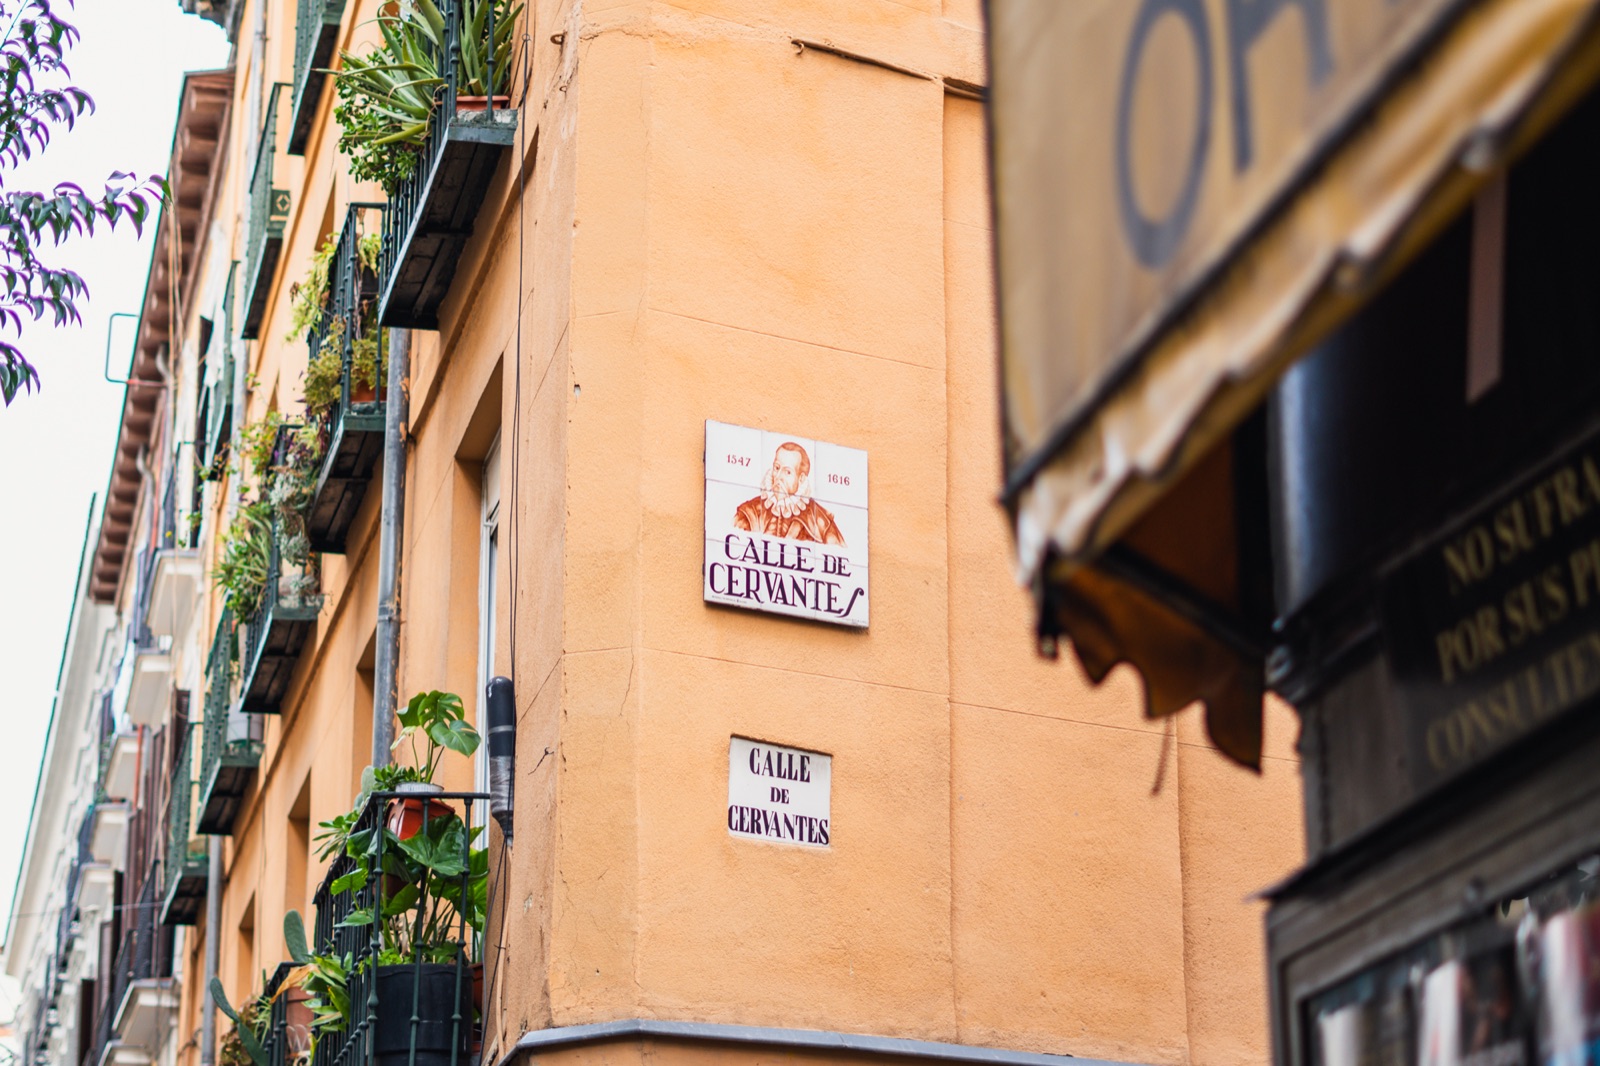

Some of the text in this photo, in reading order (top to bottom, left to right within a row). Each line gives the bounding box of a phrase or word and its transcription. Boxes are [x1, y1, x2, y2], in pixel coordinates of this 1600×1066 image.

[727, 454, 752, 467] 1547
[827, 473, 850, 486] 1616
[724, 533, 852, 577] CALLE DE
[1442, 525, 1494, 597] NO
[709, 562, 865, 618] CERVANTES
[1435, 605, 1505, 684] POR
[1503, 566, 1569, 647] SUS
[749, 747, 811, 783] CALLE
[770, 786, 790, 804] DE
[728, 804, 829, 846] CERVANTES
